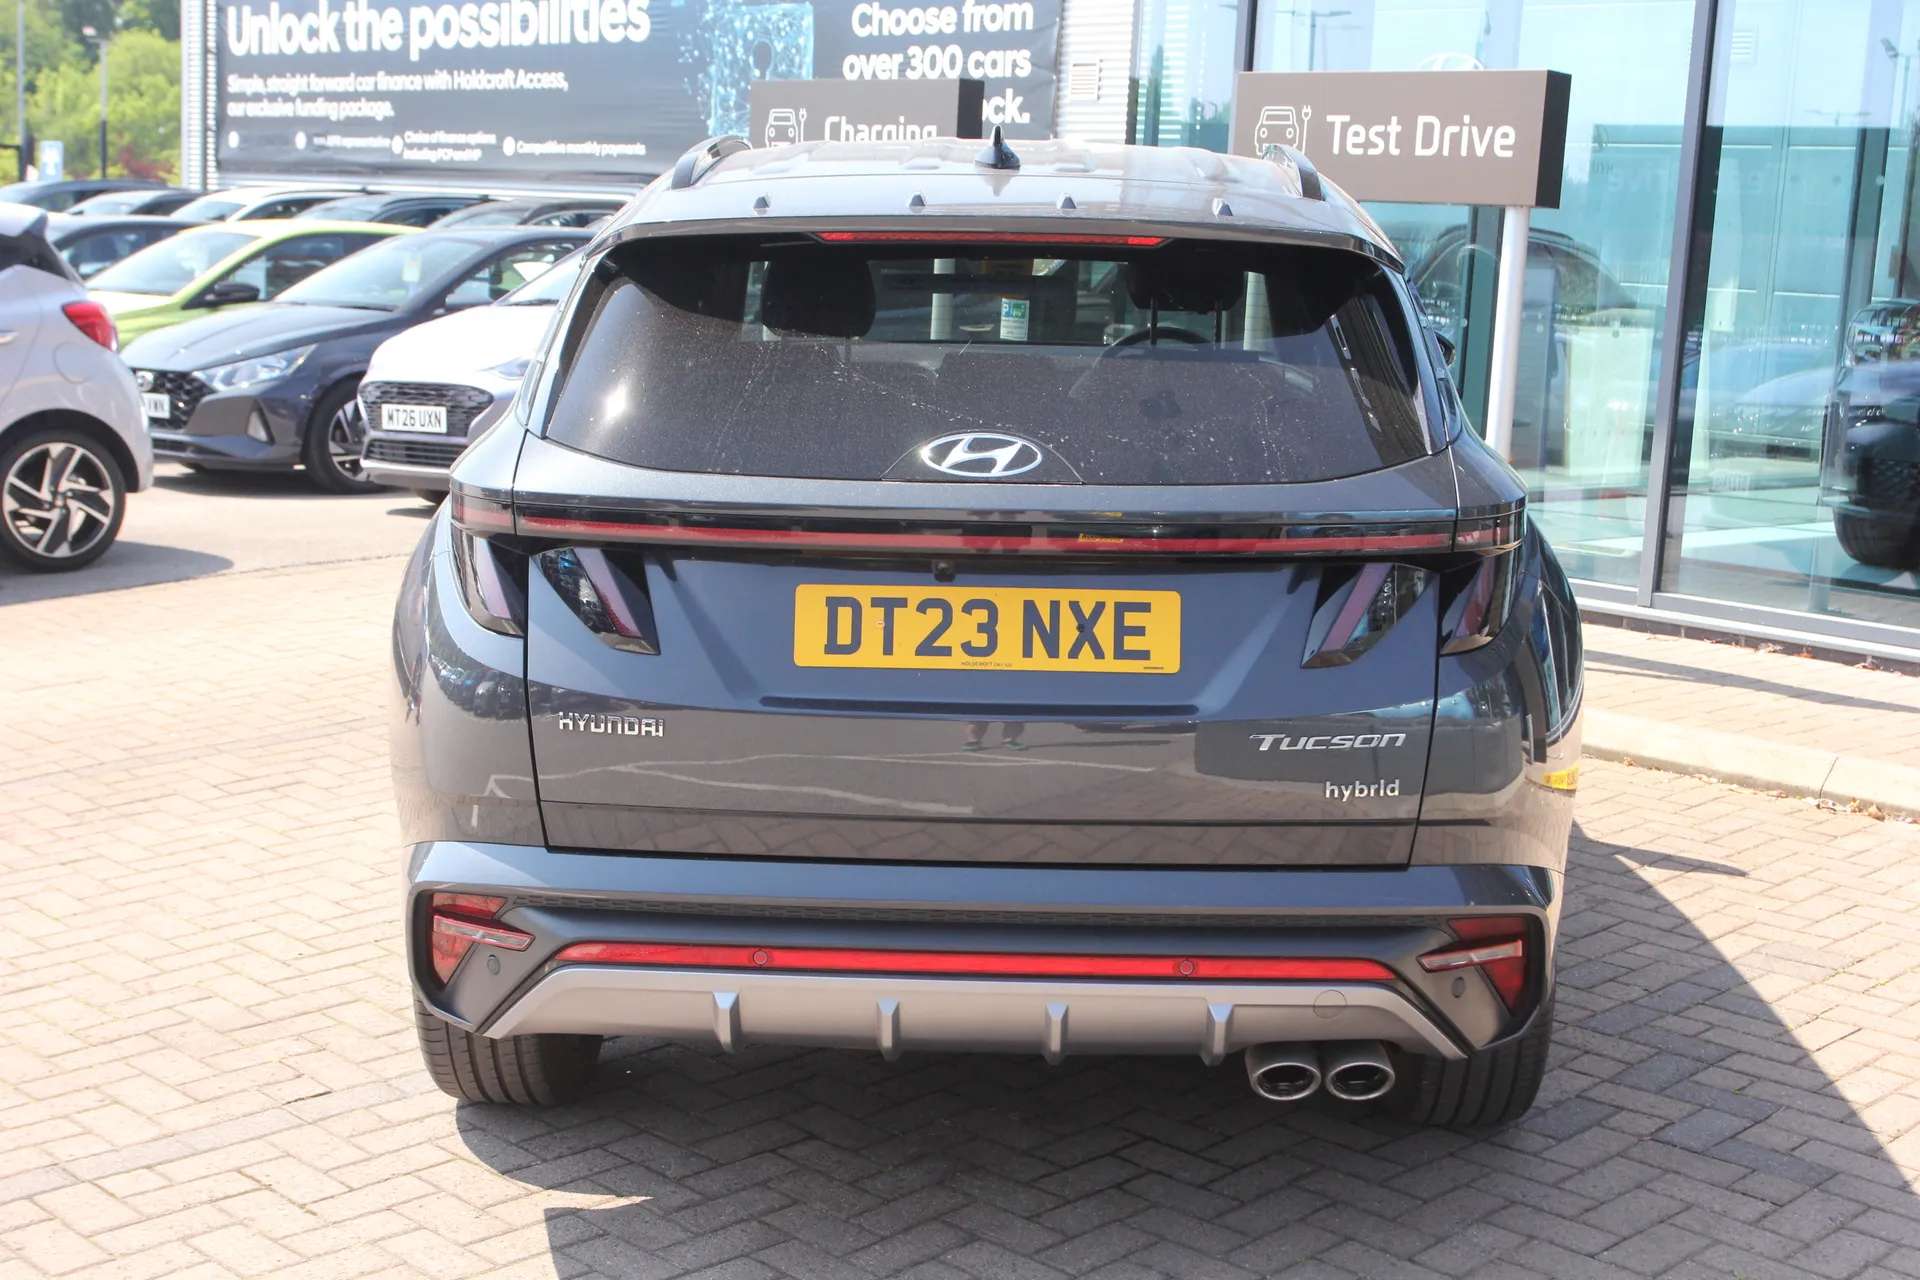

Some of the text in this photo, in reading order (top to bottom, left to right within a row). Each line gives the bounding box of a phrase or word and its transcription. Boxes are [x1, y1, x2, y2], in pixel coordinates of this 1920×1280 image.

[226, 0, 651, 61] Unlock the possibilities
[851, 0, 1034, 37] Choose from
[376, 70, 422, 92] finance
[424, 69, 452, 91] with
[453, 68, 515, 91] Holdcroft
[515, 68, 568, 92] Access,
[842, 44, 1032, 81] over 300 cars
[824, 115, 938, 144] Charging
[1326, 114, 1516, 158] Test Drive
[824, 596, 1152, 661] DT23 NXE
[558, 711, 664, 737] HYUNDAI
[1325, 778, 1400, 802] hybrid
